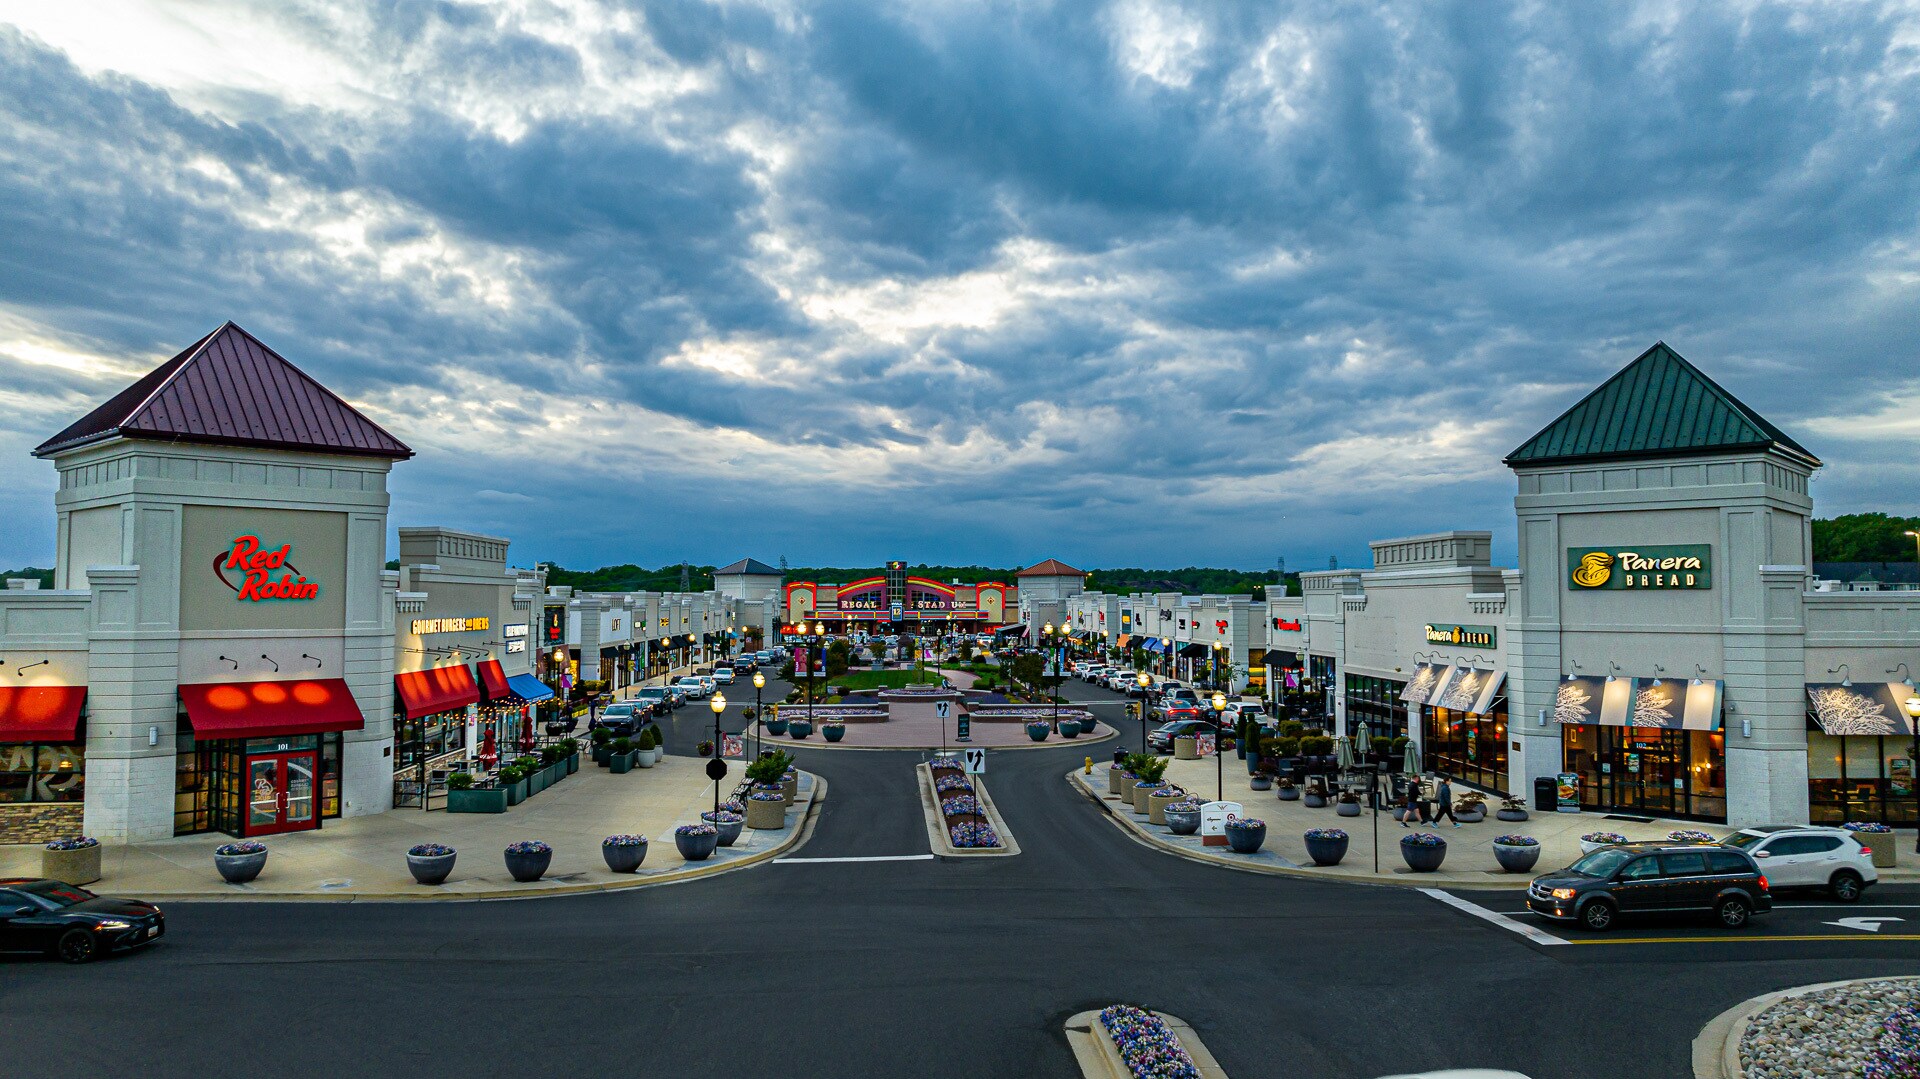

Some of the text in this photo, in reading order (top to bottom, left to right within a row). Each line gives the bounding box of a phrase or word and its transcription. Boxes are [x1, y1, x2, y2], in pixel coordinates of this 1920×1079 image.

[226, 535, 291, 571] Red
[1617, 552, 1701, 571] Panera
[238, 568, 319, 602] Robin
[1626, 574, 1695, 586] BREAD
[841, 600, 877, 609] REGAL
[412, 619, 442, 635] GOURMET
[1425, 625, 1452, 641] Panera
[277, 743, 289, 751] 101
